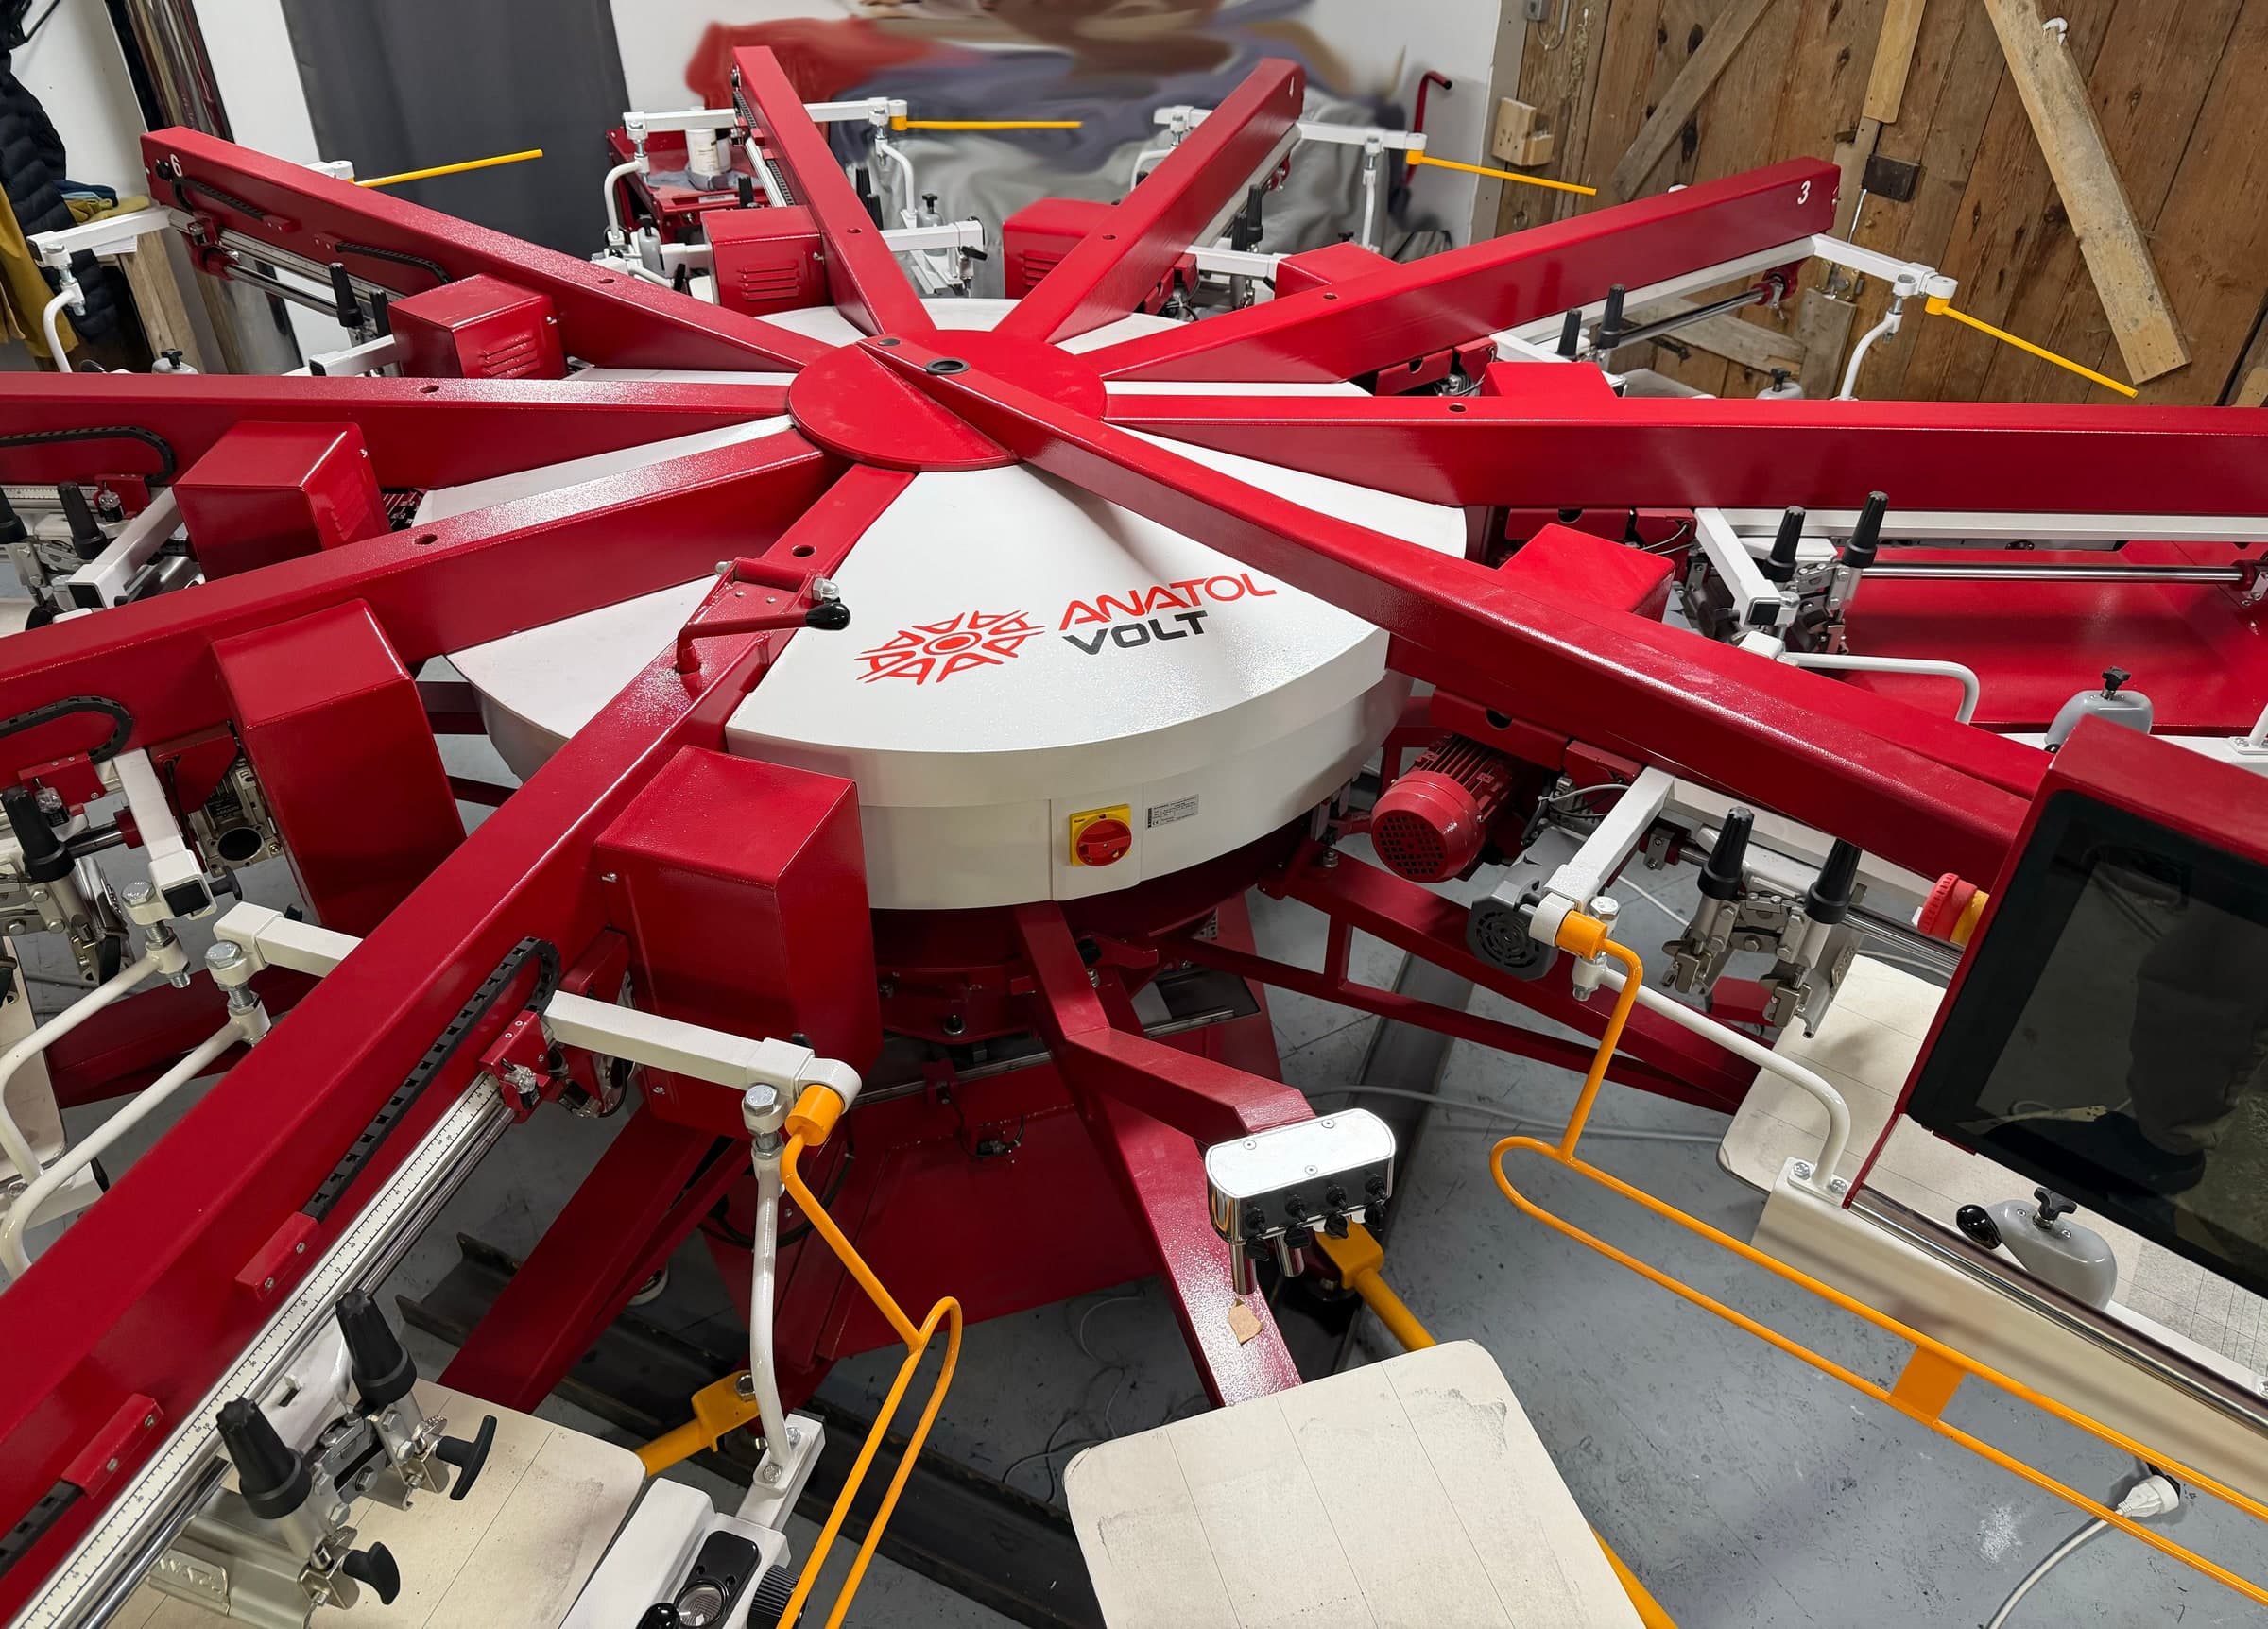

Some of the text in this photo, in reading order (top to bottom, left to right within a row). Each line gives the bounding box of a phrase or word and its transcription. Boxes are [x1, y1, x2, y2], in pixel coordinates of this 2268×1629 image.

[169, 153, 183, 178] 6
[1797, 180, 1811, 205] 3
[1058, 573, 1278, 631] ANATOL
[1061, 609, 1209, 656] VOLT
